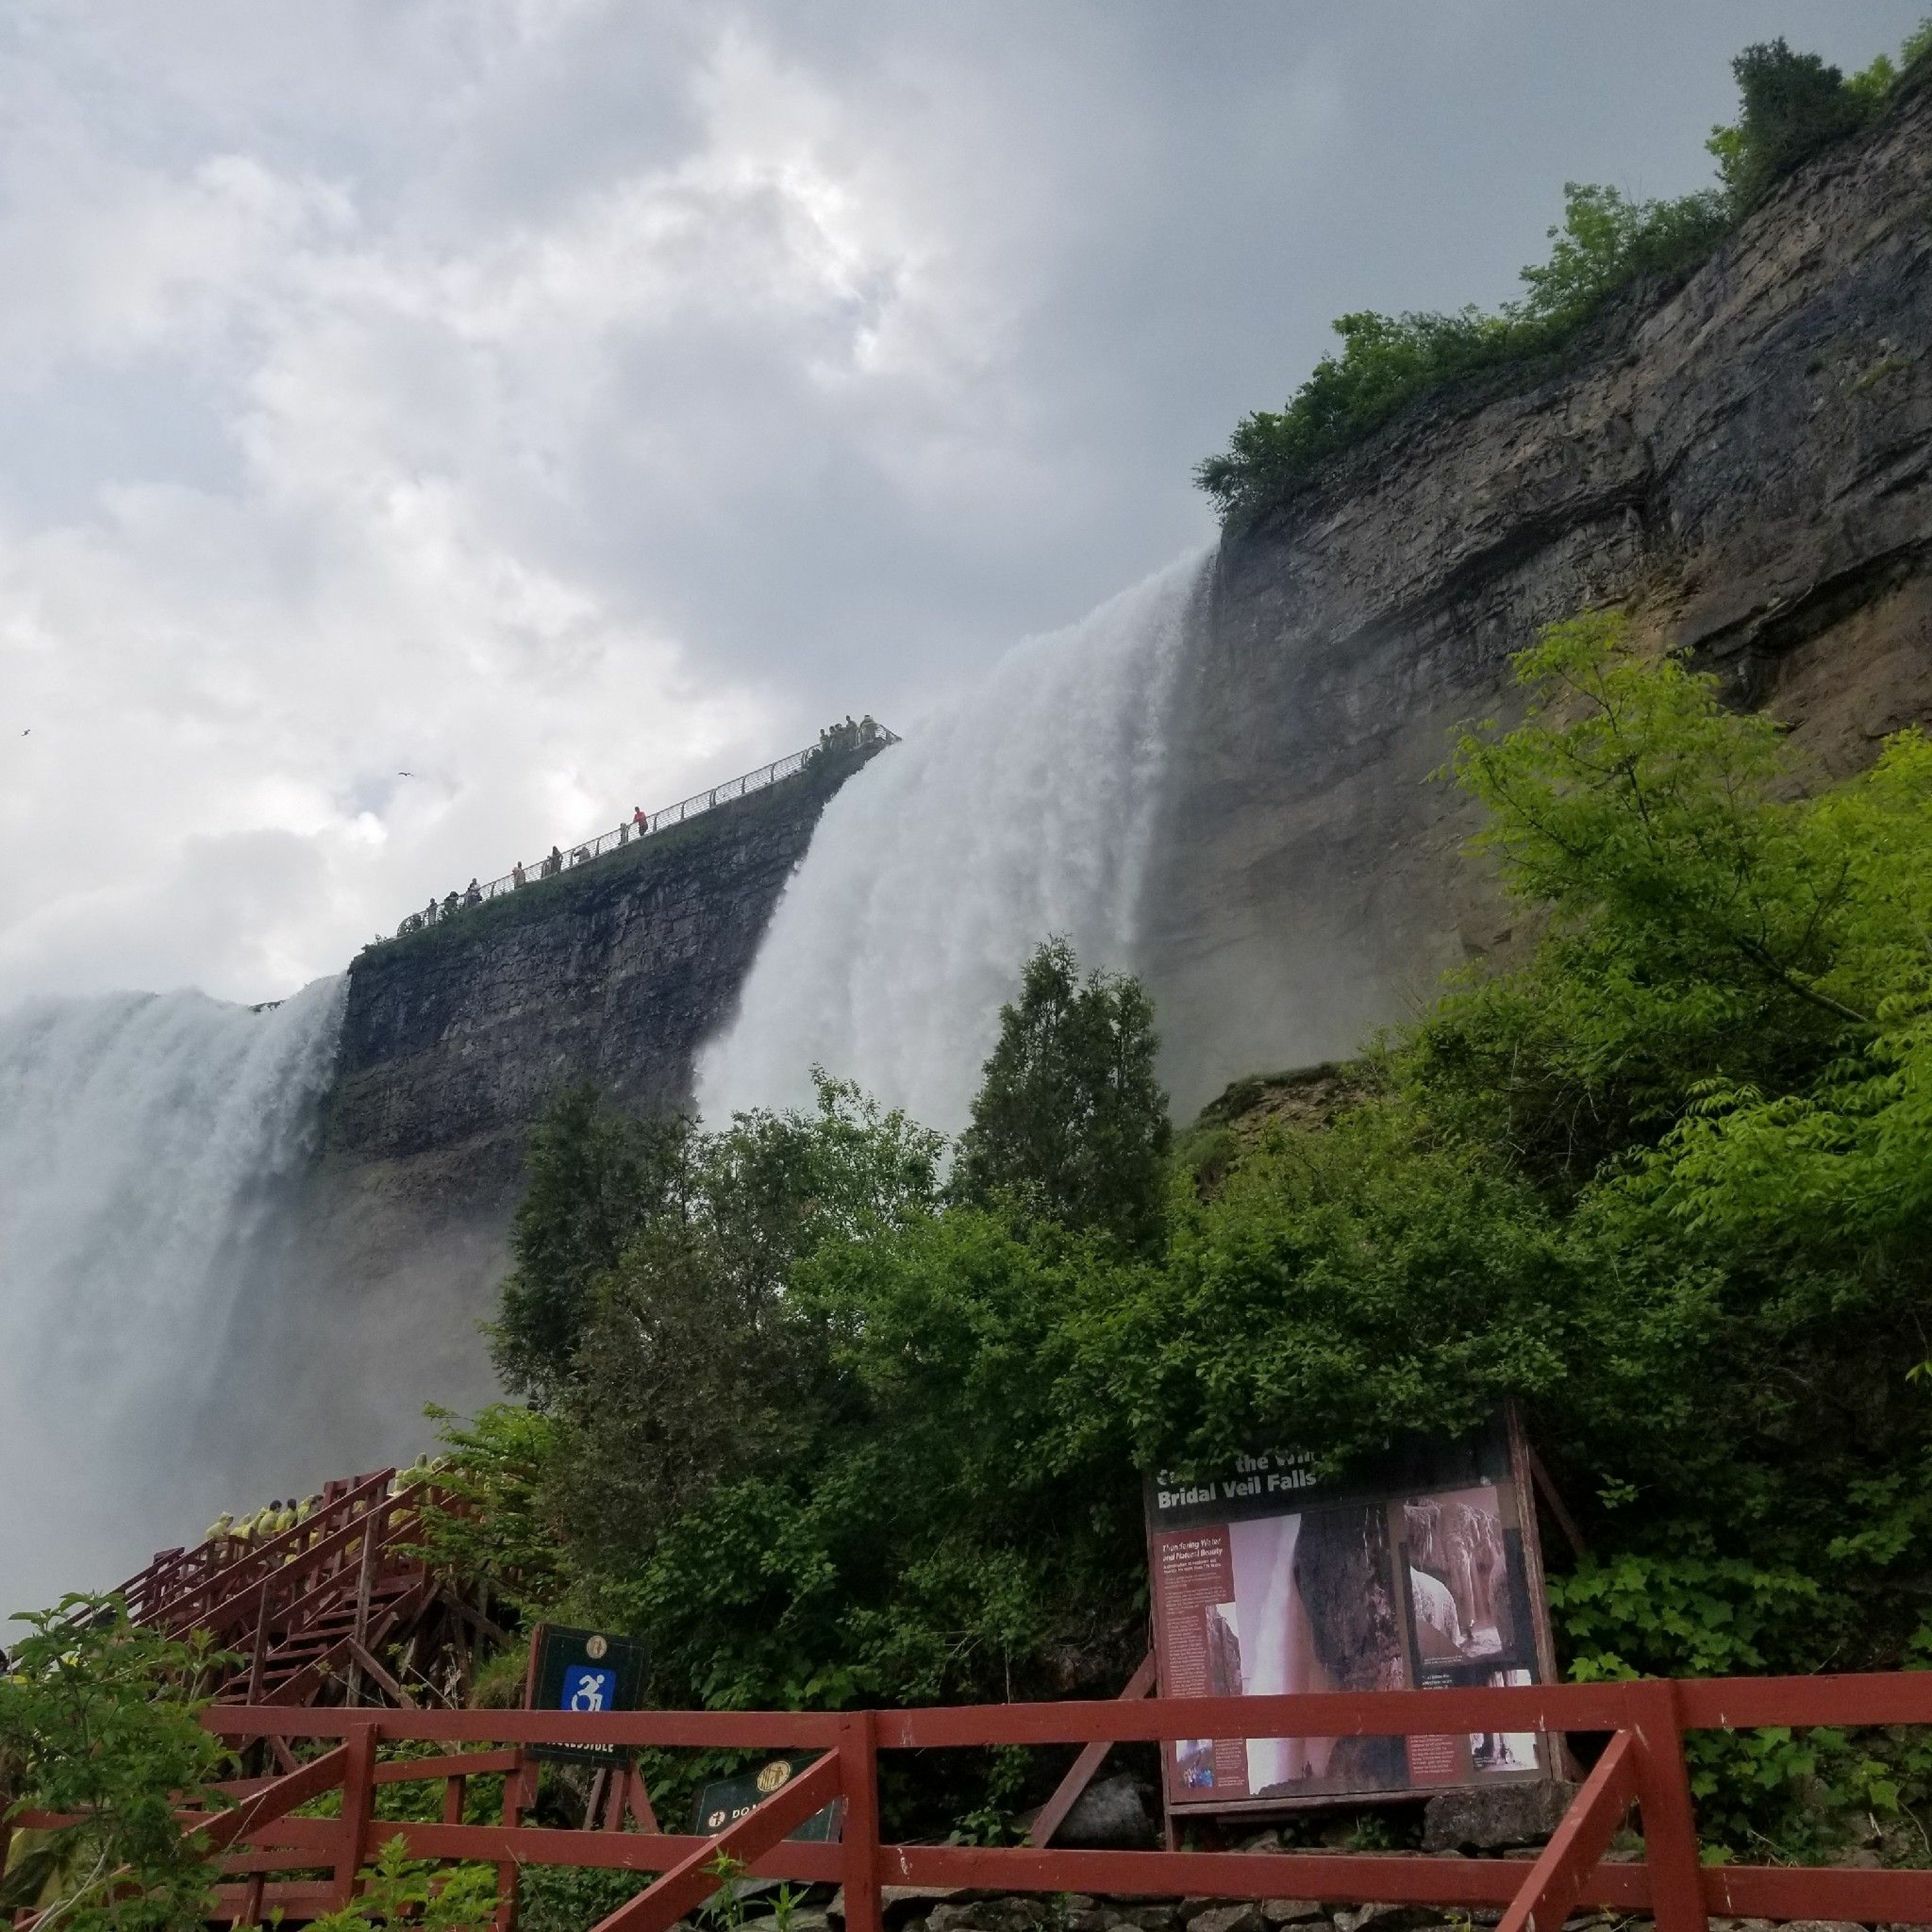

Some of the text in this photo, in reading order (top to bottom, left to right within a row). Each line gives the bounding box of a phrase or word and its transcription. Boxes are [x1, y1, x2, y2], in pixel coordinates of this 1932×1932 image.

[1235, 1454, 1269, 1473] the
[1158, 1469, 1317, 1509] Bridal Veil Falls
[1162, 1538, 1222, 1552] Thundering Water
[1162, 1548, 1222, 1562] and Natural Beauty
[732, 1806, 750, 1819] DO
